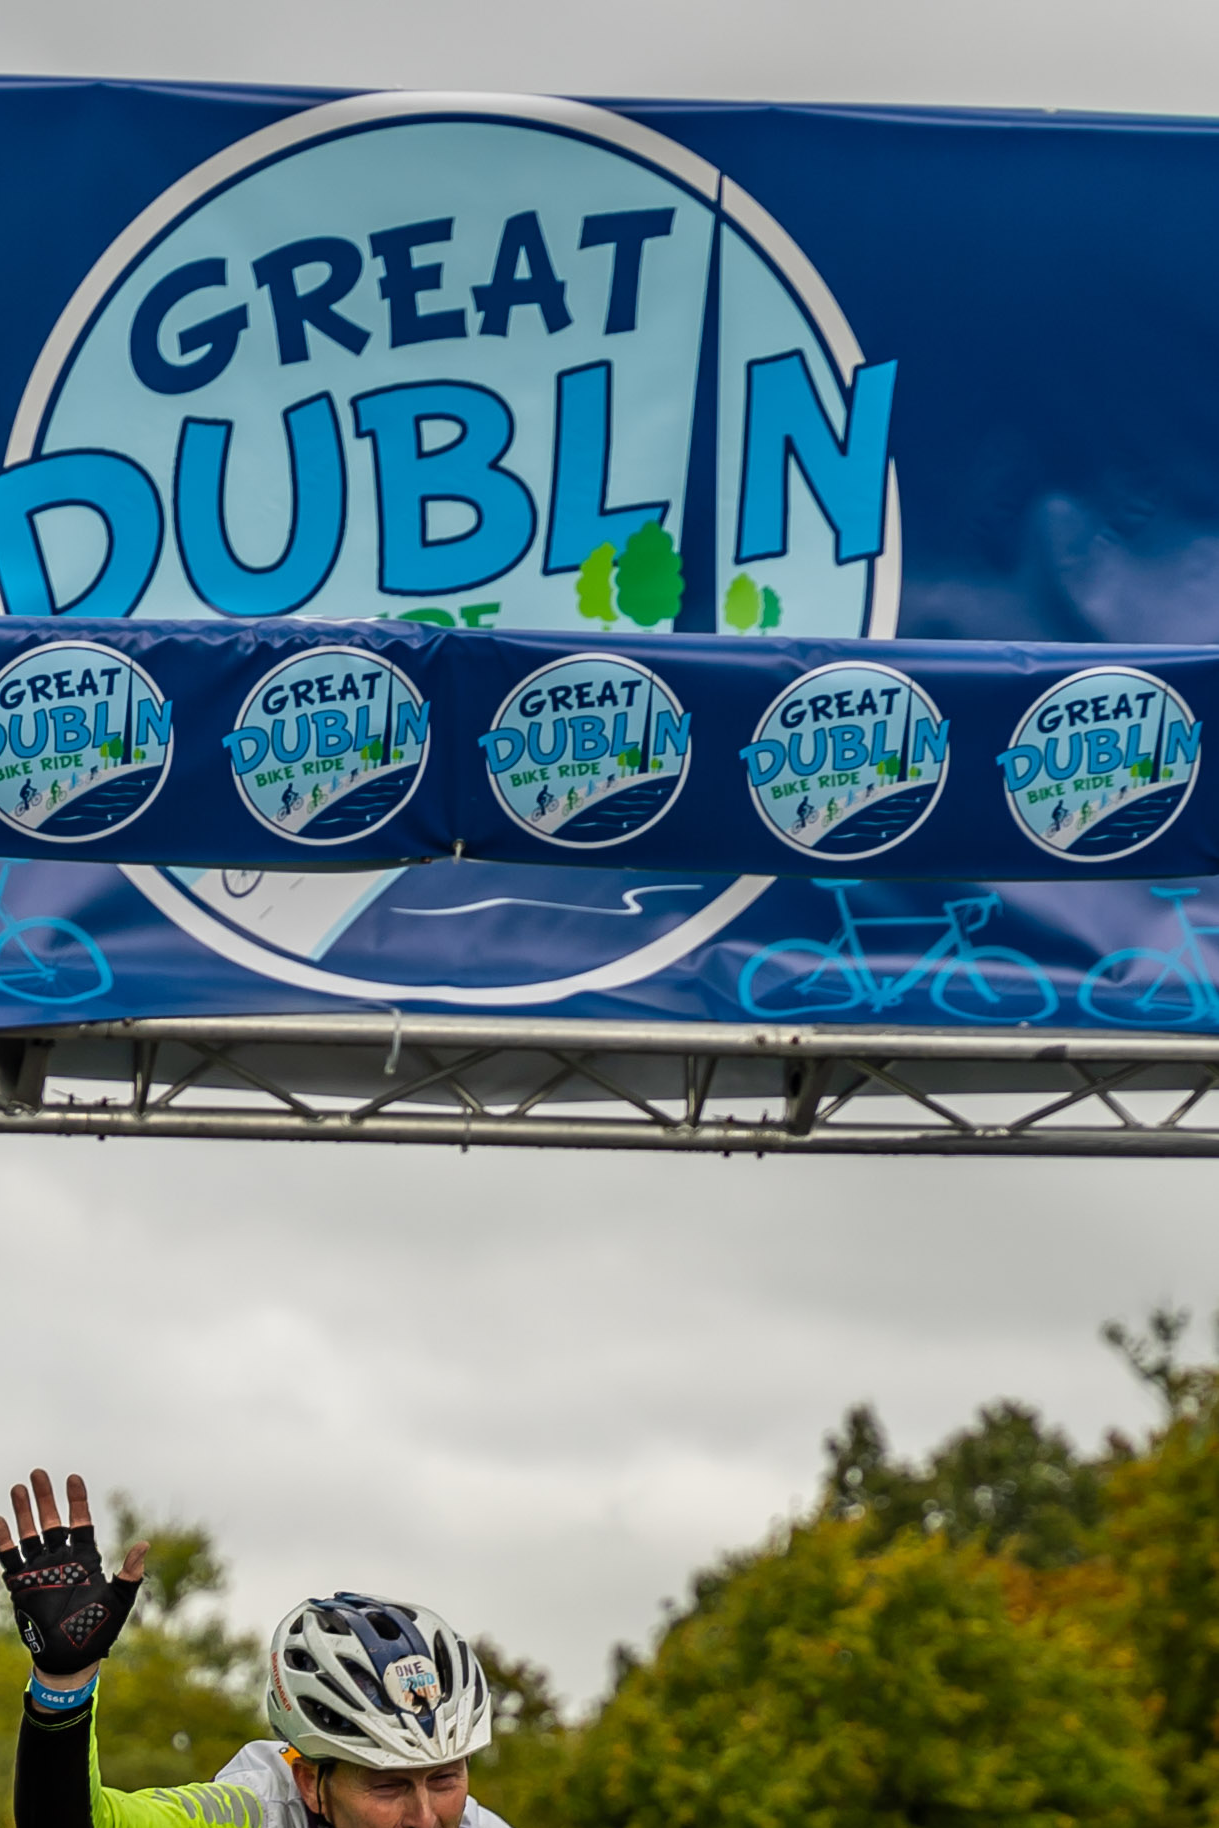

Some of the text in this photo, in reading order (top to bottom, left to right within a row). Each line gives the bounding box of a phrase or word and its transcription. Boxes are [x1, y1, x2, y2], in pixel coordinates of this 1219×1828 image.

[128, 206, 677, 395] GREAT
[259, 672, 382, 715] GREAT
[518, 679, 642, 718] GREAT
[780, 687, 902, 729] GREAT
[1036, 690, 1157, 735] GREAT
[42, 753, 84, 771] RIDE
[255, 757, 345, 788] BIKE RIDE
[510, 761, 601, 788] BIKE RIDE
[771, 772, 861, 800] BIKE RIDE
[1027, 775, 1114, 805] BIKE RIDE
[24, 1621, 41, 1654] GEL
[395, 1661, 424, 1677] ONE
